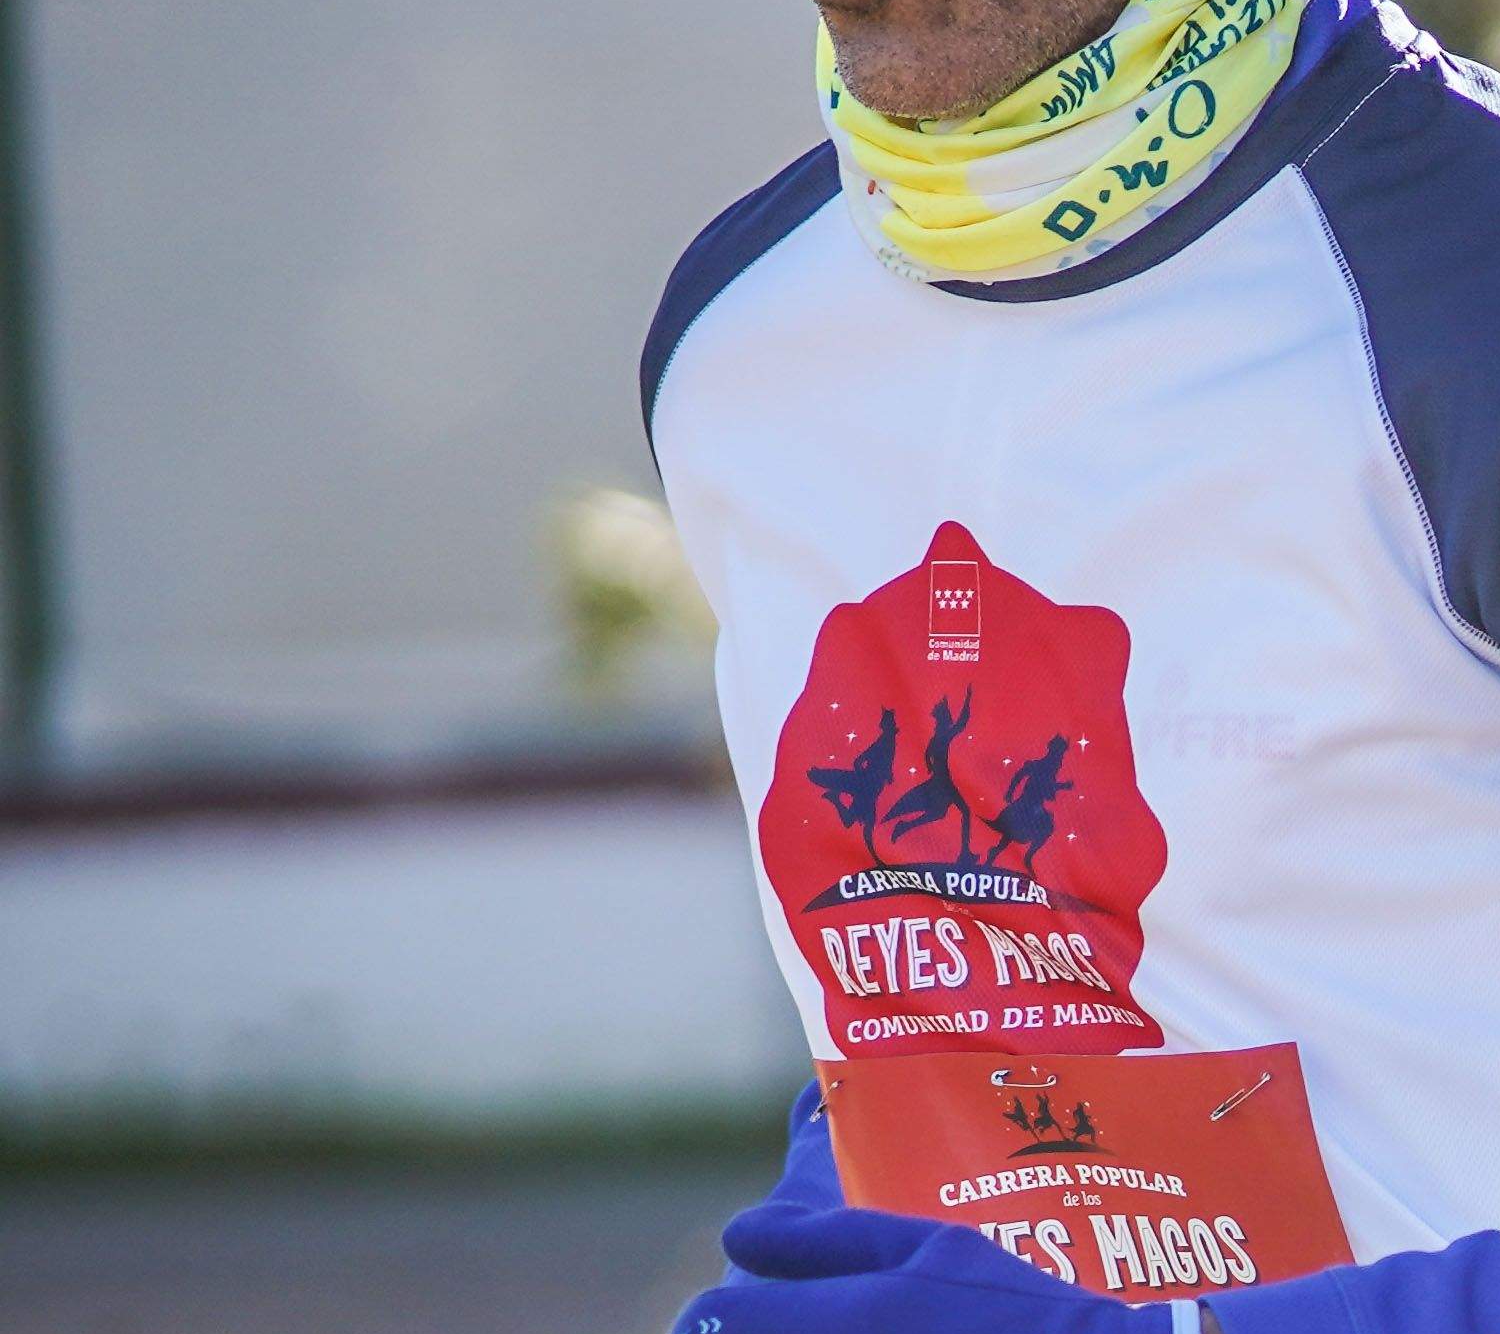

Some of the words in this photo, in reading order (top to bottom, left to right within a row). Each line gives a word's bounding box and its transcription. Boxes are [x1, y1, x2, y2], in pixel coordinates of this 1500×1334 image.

[942, 649, 979, 662] Madrid
[839, 871, 941, 899] CARRERA
[820, 916, 970, 997] REYES
[847, 1009, 989, 1044] COMUNIDAD
[1001, 1006, 1044, 1030] DE
[1053, 1003, 1145, 1028] MADRID
[939, 1164, 1075, 1207] CARRERA
[1074, 1164, 1188, 1198] POPULAR
[1063, 1191, 1081, 1207] de
[1083, 1190, 1102, 1206] los
[1088, 1214, 1258, 1289] MAGOS
